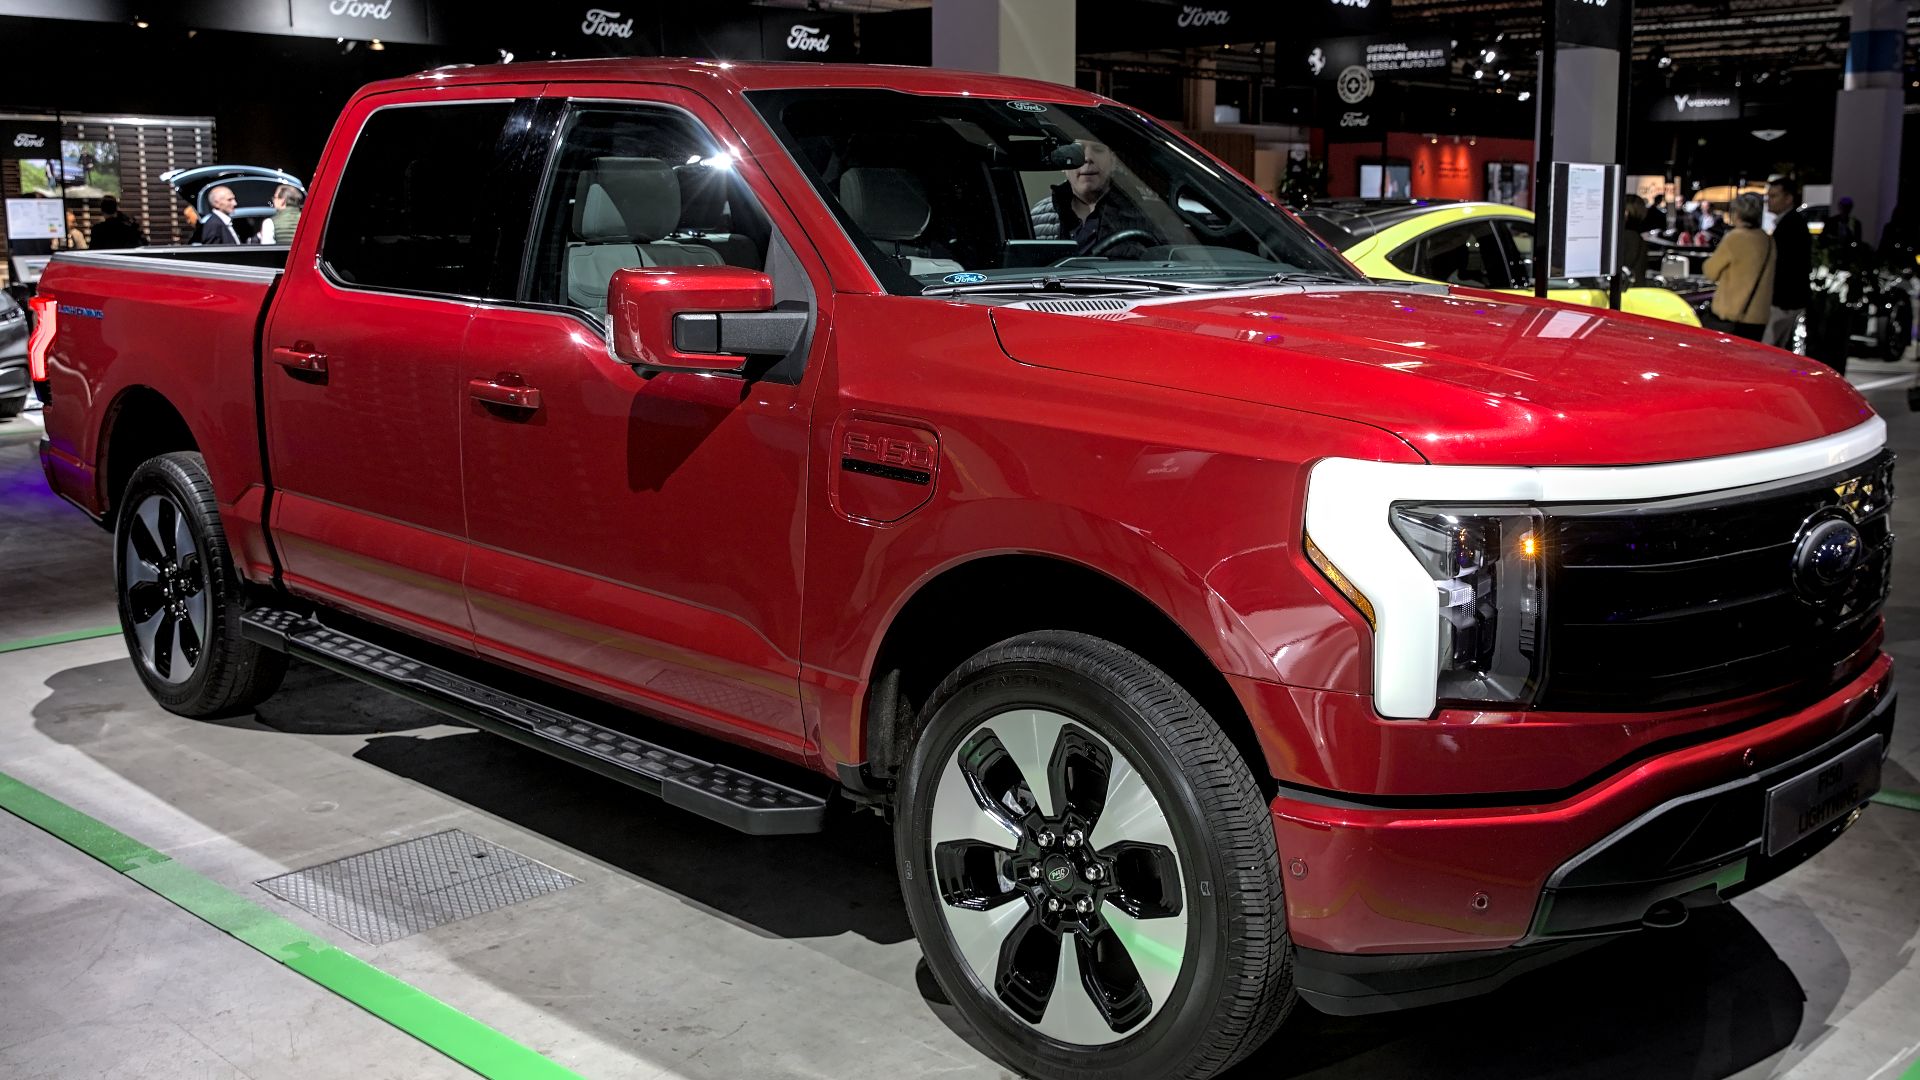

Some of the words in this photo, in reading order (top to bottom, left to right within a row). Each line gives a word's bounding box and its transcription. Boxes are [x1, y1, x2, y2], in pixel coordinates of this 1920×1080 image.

[581, 8, 634, 39] Ford
[786, 24, 830, 52] Ford
[1366, 43, 1408, 53] OFFICIAL
[1366, 52, 1405, 62] FERRARI
[1406, 49, 1443, 60] DEALER
[1400, 59, 1425, 69] AUTO
[1340, 111, 1370, 127] Ford
[13, 133, 45, 147] Ford
[843, 431, 935, 471] F-150
[1817, 763, 1843, 793] F150
[1798, 783, 1859, 834] LIGHTNING
